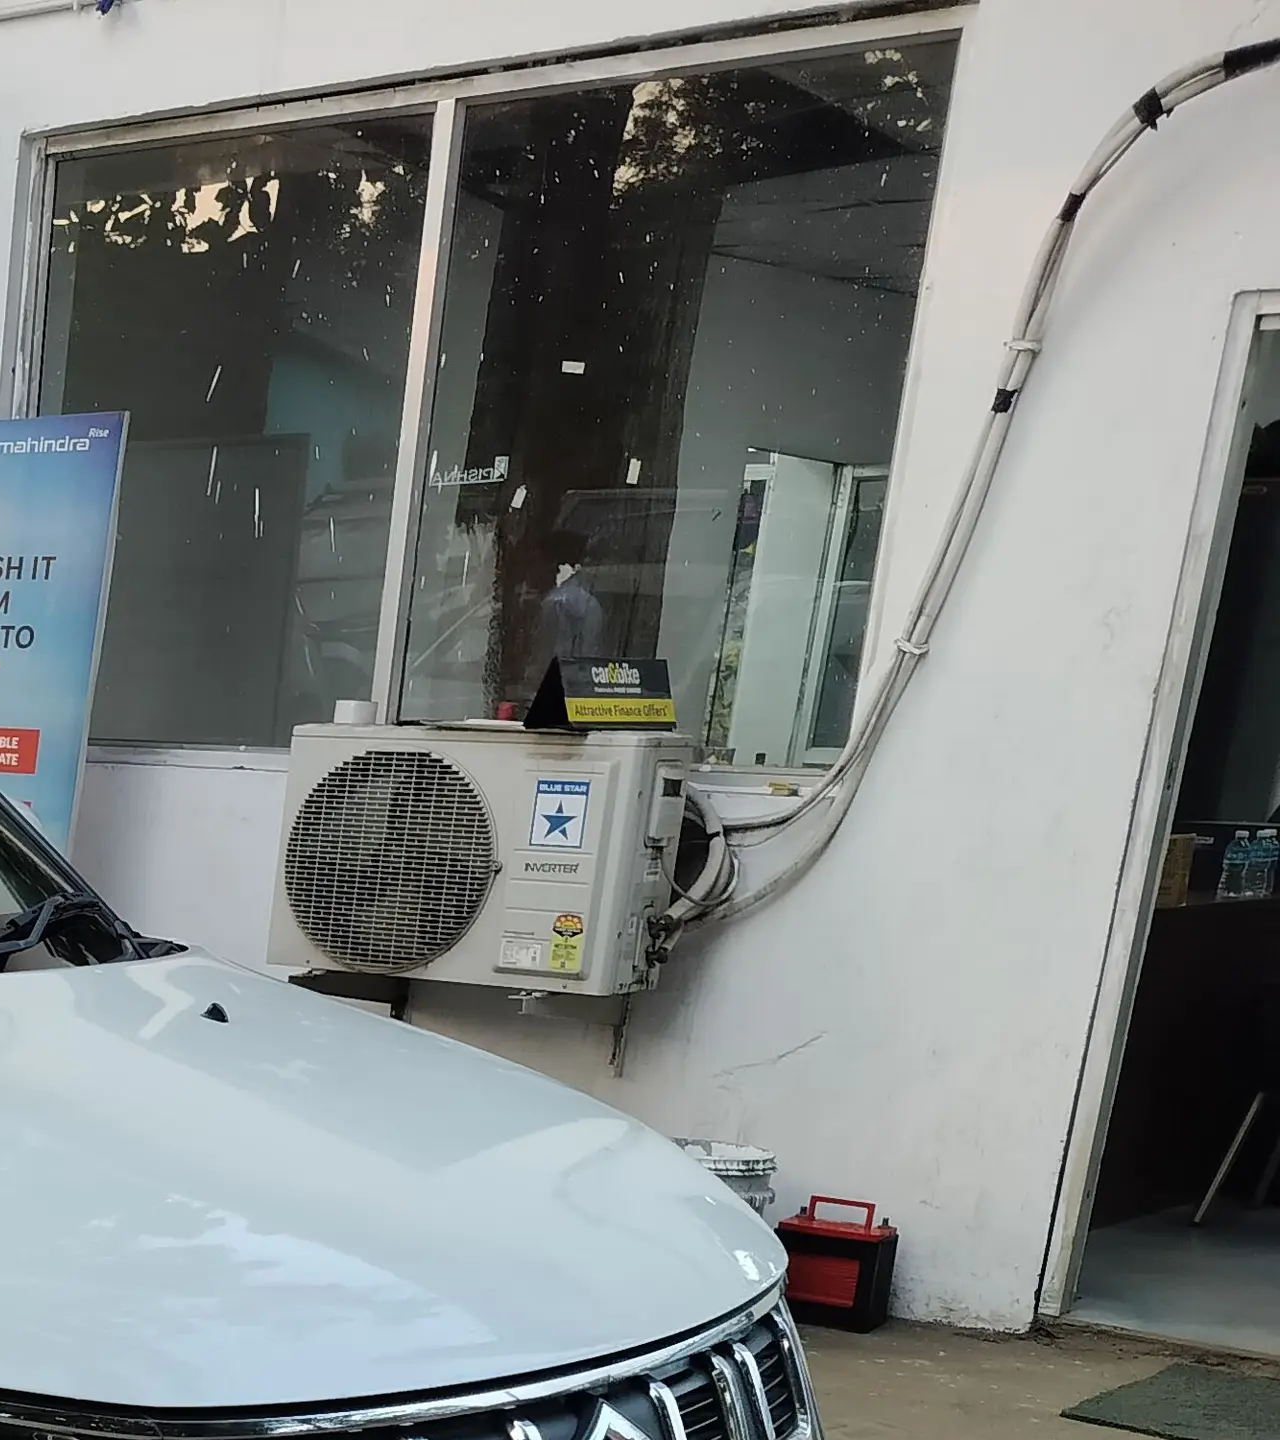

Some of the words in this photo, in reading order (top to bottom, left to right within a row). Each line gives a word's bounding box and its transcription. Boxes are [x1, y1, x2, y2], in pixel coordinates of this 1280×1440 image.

[88, 428, 110, 438] Rise
[31, 556, 57, 580] IT
[1, 625, 35, 649] TO
[591, 663, 641, 685] car&bike
[575, 704, 613, 717] Attractive
[539, 783, 562, 792] BLUE
[564, 784, 588, 793] STAR
[524, 862, 580, 874] INVERTER
